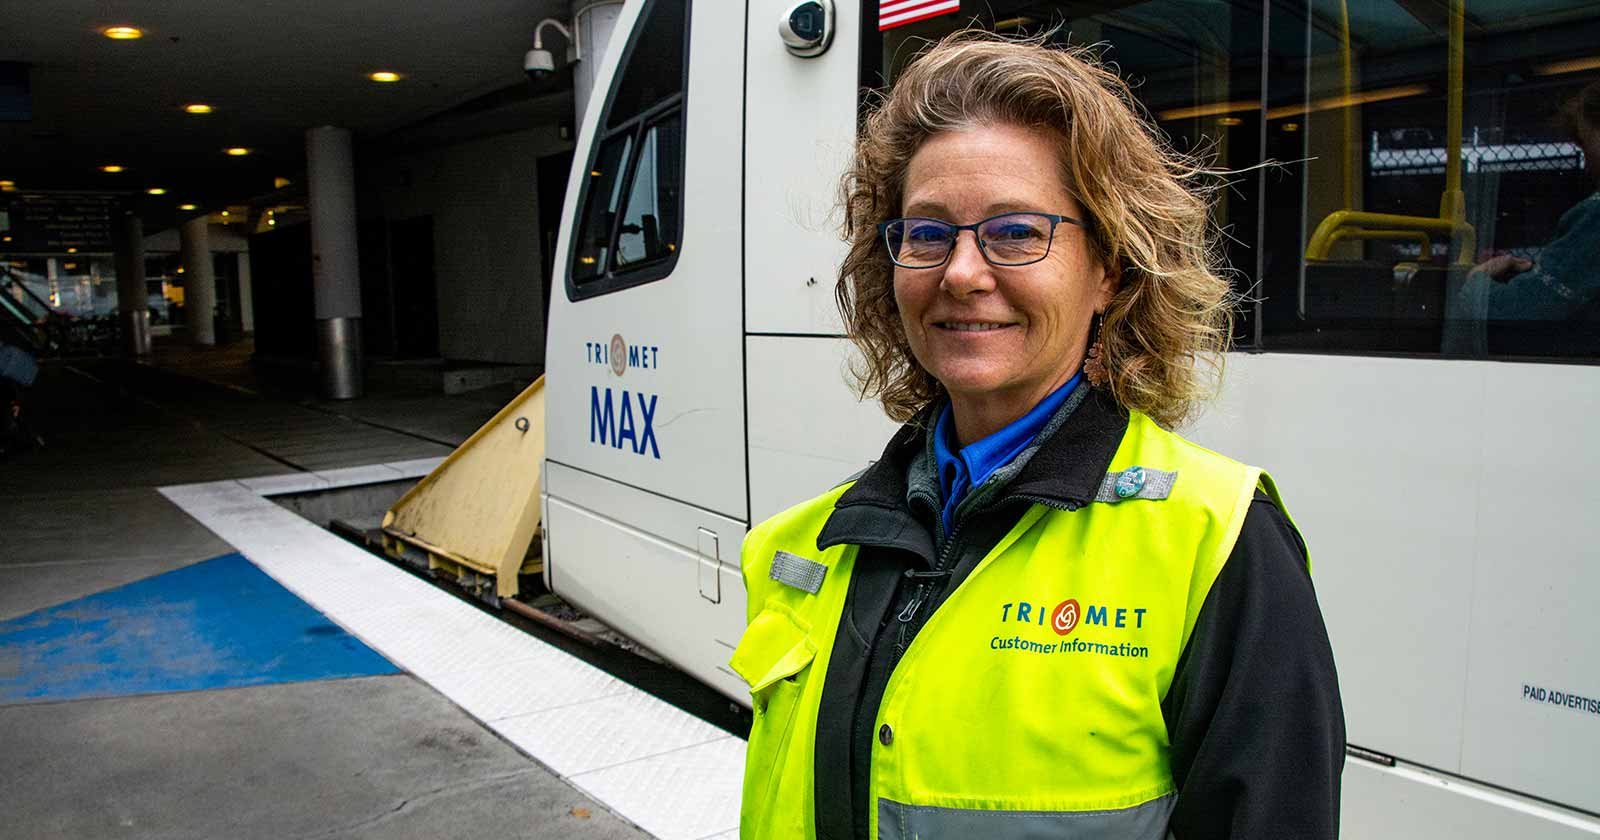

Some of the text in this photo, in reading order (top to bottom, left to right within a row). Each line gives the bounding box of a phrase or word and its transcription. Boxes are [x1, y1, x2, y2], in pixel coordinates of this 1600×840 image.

[590, 385, 661, 460] MAX
[990, 636, 1149, 658] Customer Information
[1523, 684, 1547, 702] PAID
